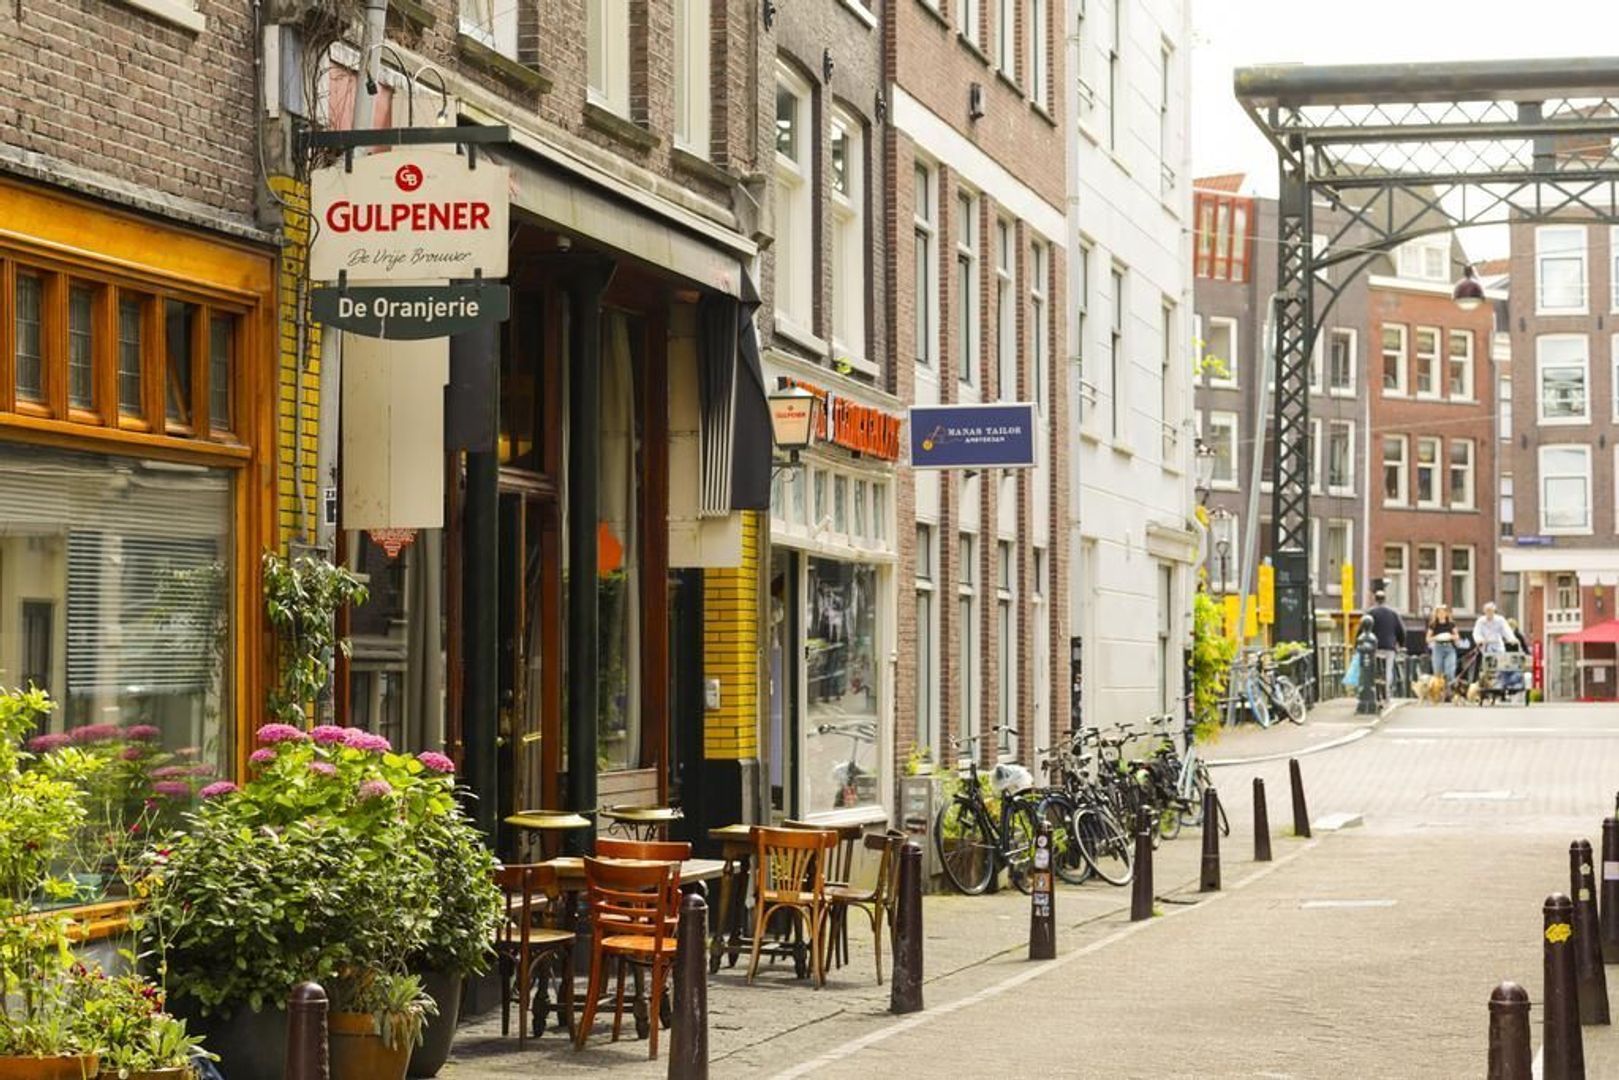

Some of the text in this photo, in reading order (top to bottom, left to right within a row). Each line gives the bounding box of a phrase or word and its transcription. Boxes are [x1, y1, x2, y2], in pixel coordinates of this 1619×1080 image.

[326, 201, 490, 233] GULPENER
[347, 247, 472, 272] De Vrije Brouwer
[338, 296, 480, 323] De Oranjerie
[985, 426, 1022, 435] TAILOR
